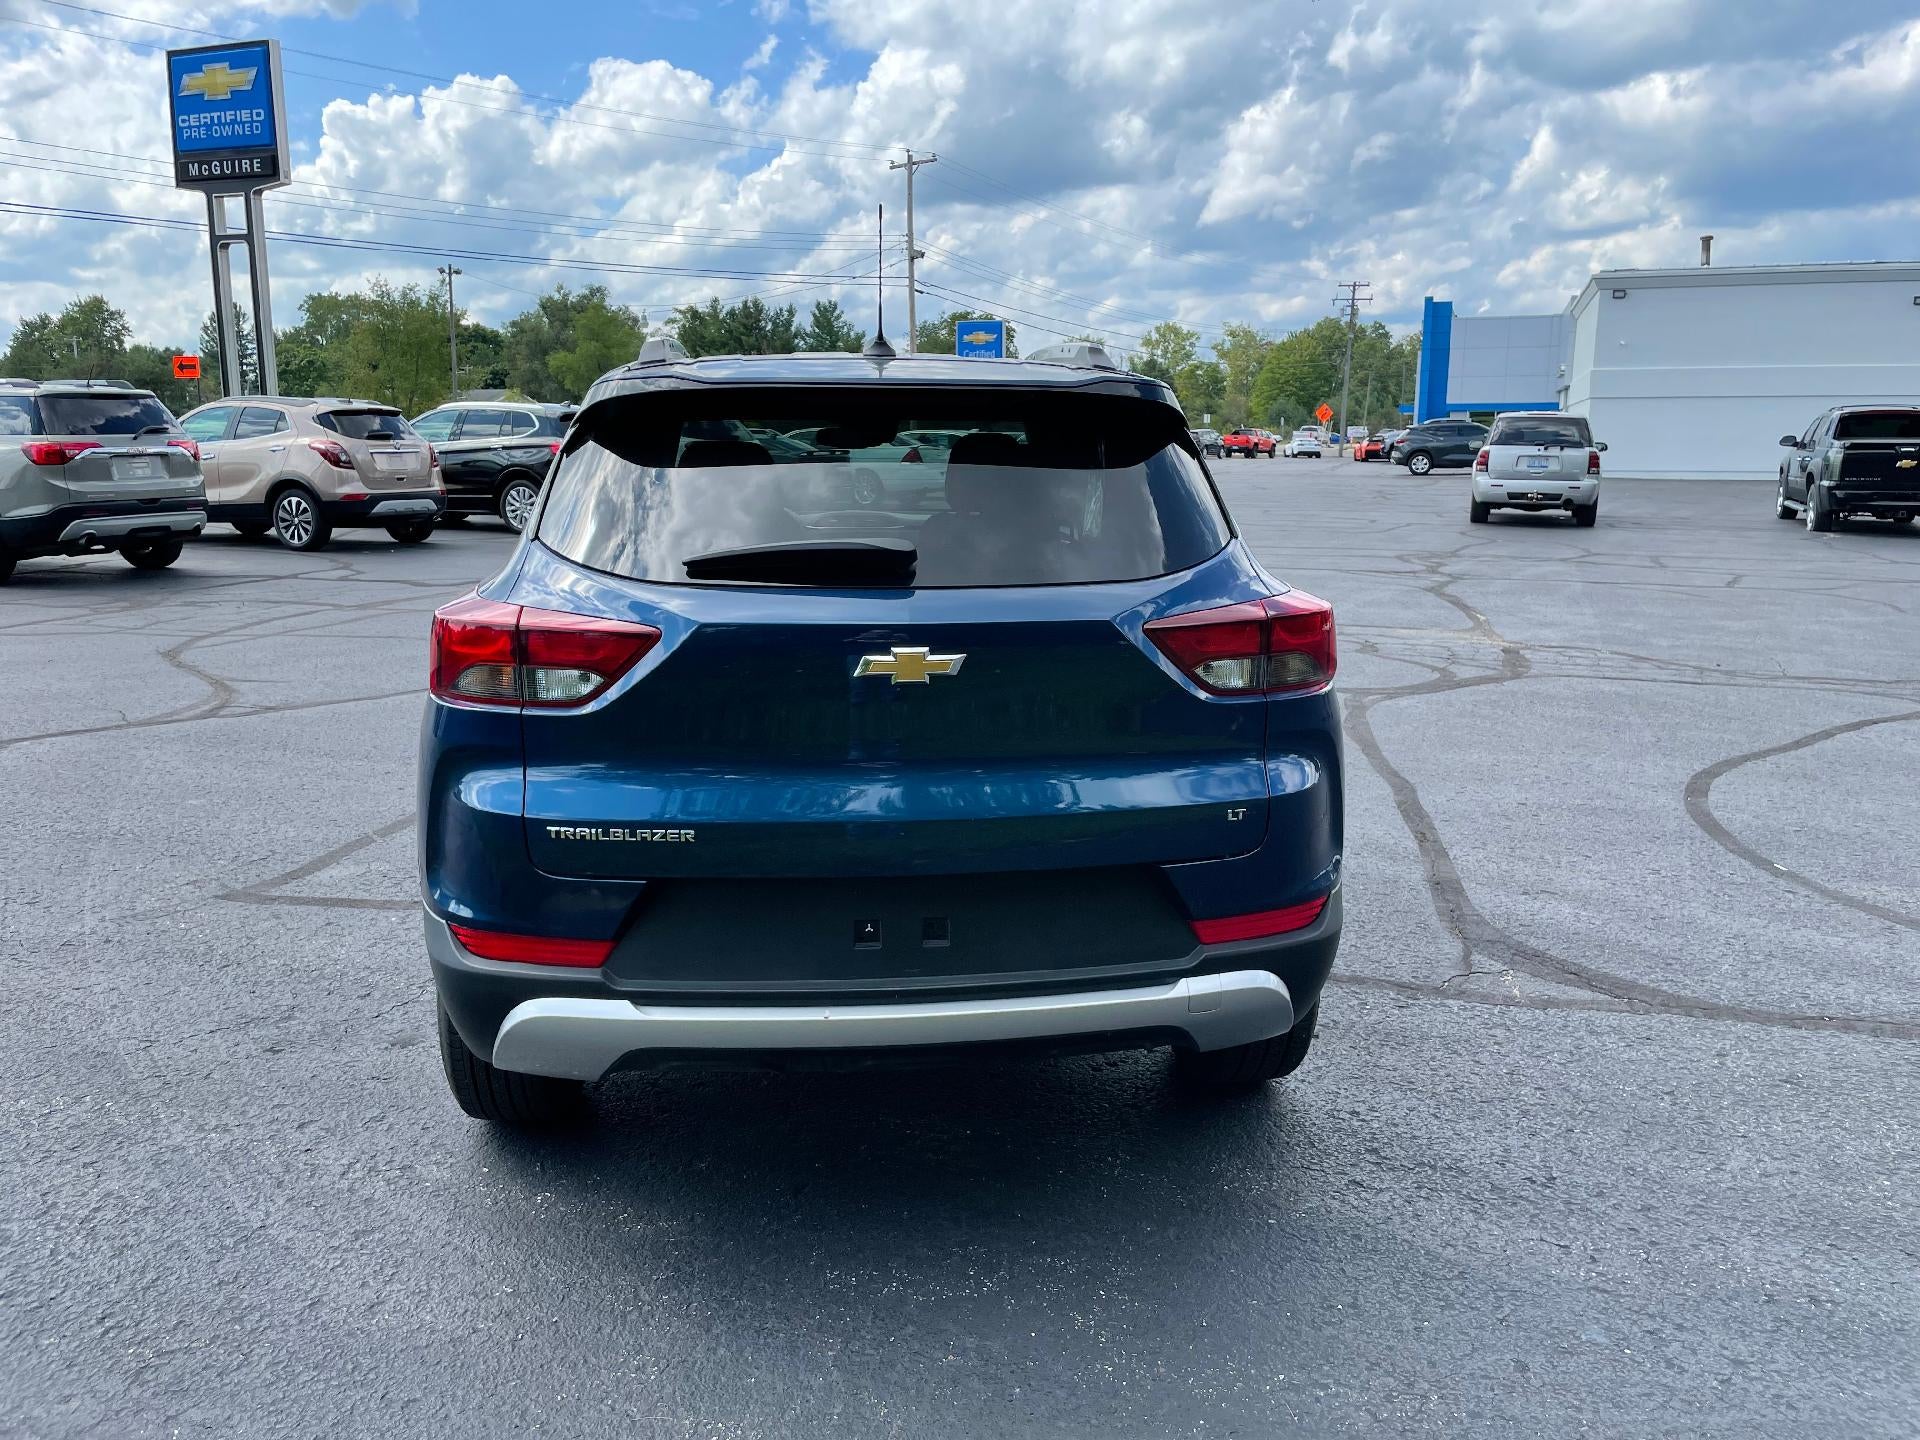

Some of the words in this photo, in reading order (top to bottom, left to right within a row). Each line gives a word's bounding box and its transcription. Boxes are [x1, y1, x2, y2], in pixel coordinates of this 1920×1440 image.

[178, 108, 265, 127] CERTIFIED
[183, 122, 262, 140] PRE-OWNED
[188, 158, 262, 176] McGUIRE
[1227, 808, 1247, 821] LT
[546, 826, 695, 842] TRAILBLAZER
